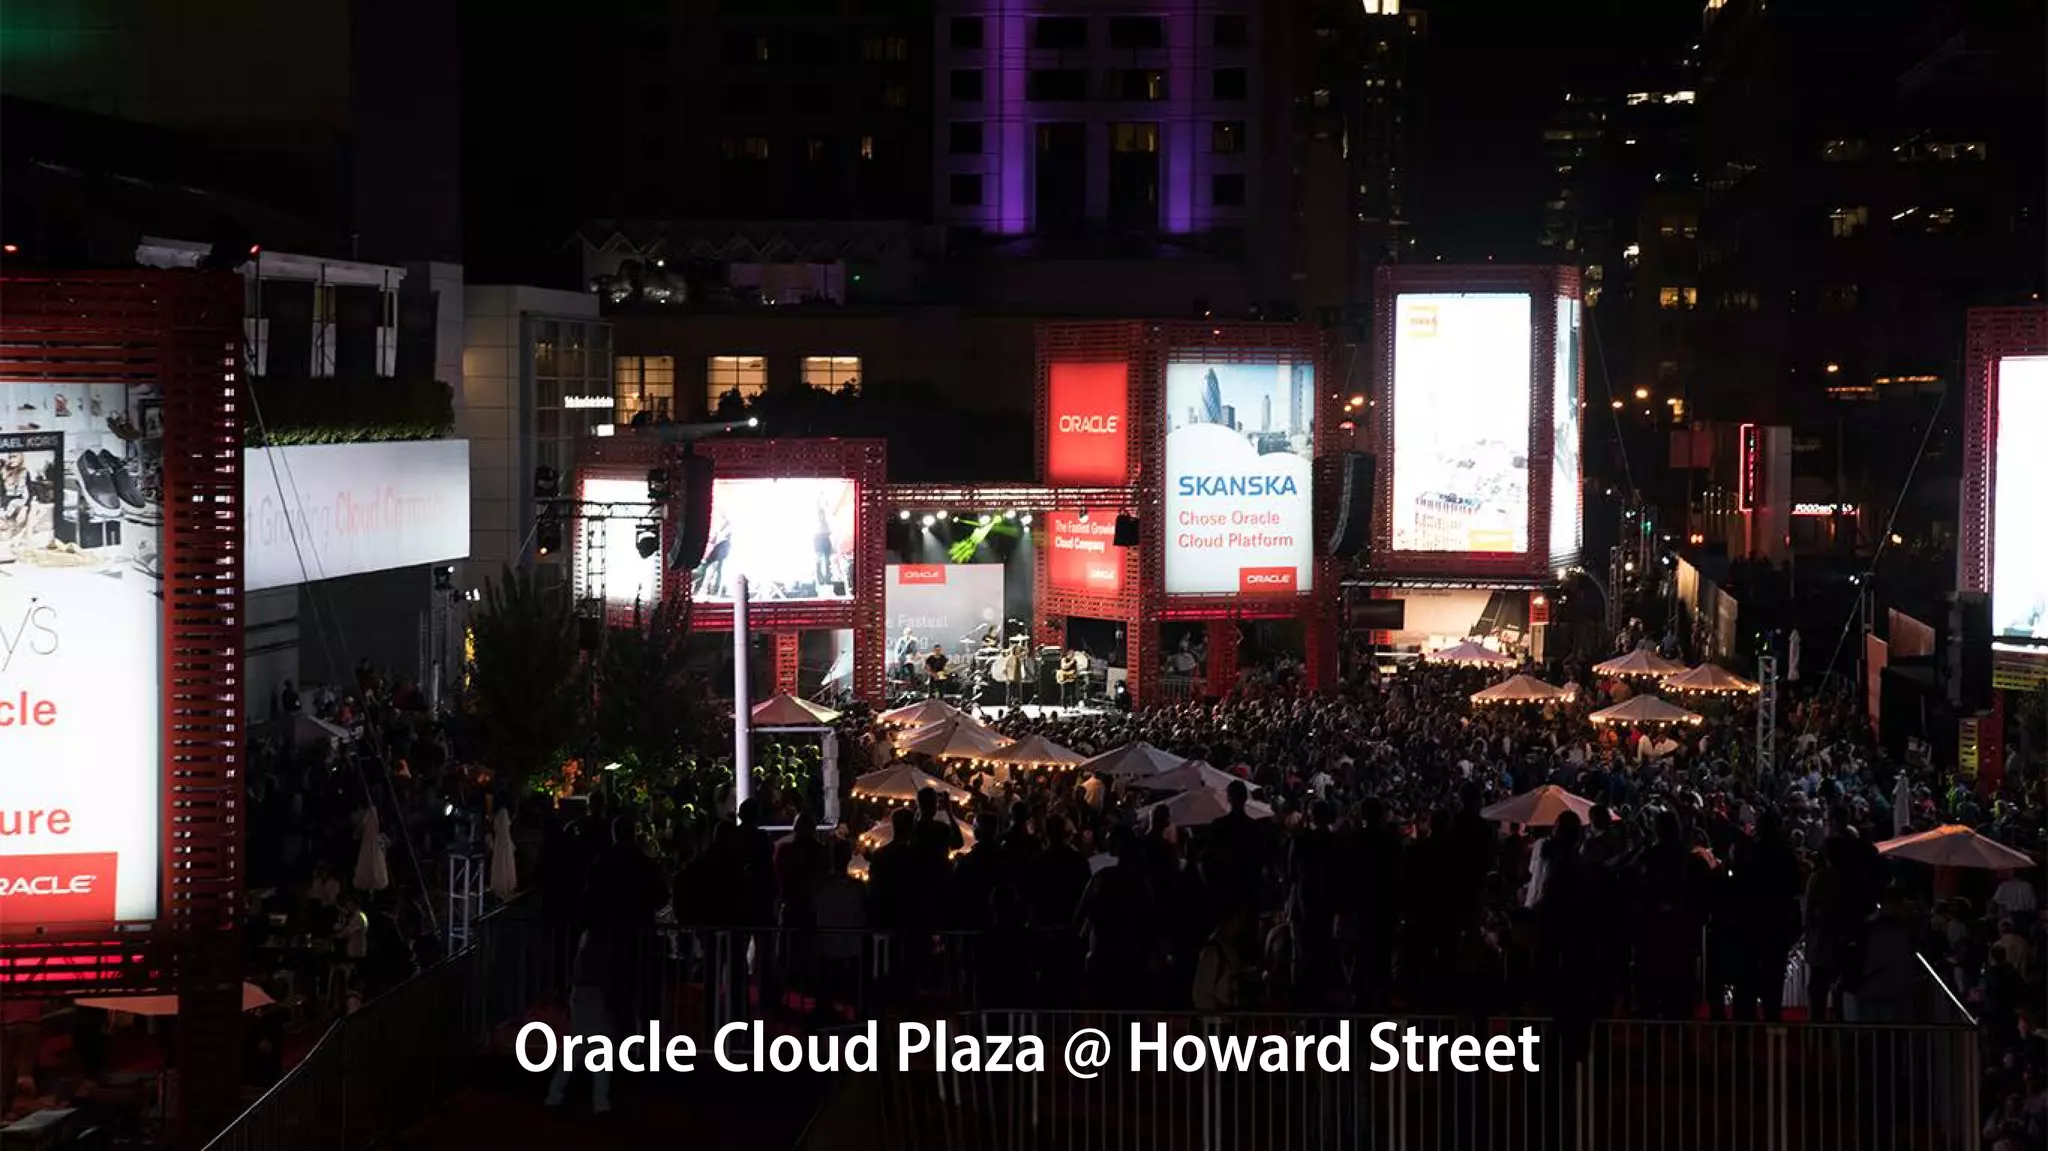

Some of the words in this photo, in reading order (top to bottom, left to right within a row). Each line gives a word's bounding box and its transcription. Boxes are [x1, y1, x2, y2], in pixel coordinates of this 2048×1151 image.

[1059, 415, 1118, 433] ORACLE
[1178, 475, 1297, 497] SKANSKA
[334, 488, 382, 536] Cloud
[1178, 510, 1227, 527] Chose
[1231, 509, 1281, 527] Oracle
[1178, 533, 1224, 549] Cloud
[1228, 532, 1294, 548] Platform
[903, 570, 940, 580] ORACLE
[1246, 573, 1290, 584] ORACLE
[0, 808, 72, 836] ure
